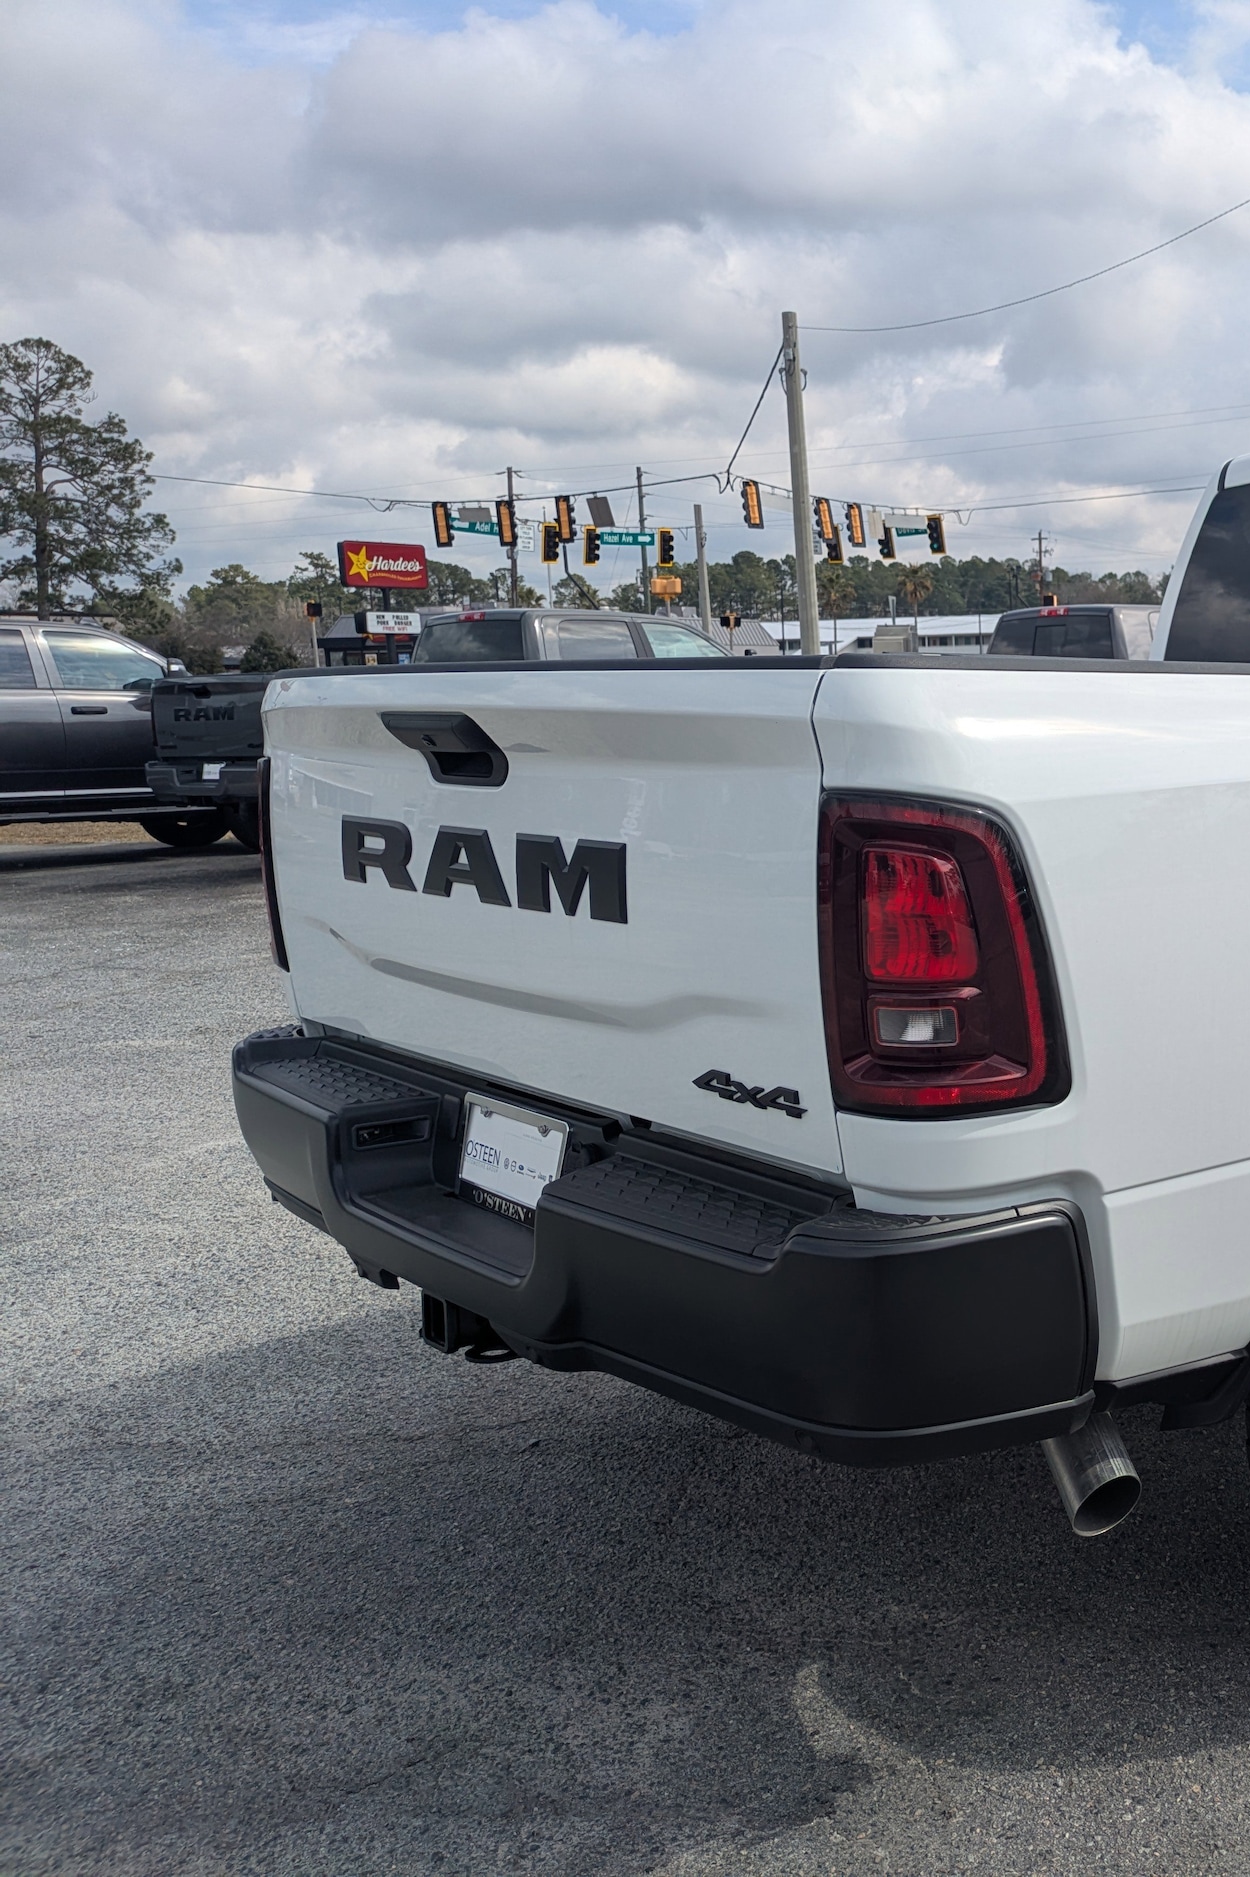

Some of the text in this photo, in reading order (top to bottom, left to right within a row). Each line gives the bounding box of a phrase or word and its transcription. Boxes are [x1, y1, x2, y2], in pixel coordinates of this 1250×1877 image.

[475, 520, 490, 533] Adel
[603, 533, 634, 544] Hazel Ave
[365, 555, 424, 573] Hardee's
[174, 706, 235, 721] RAM
[341, 814, 628, 925] RAM
